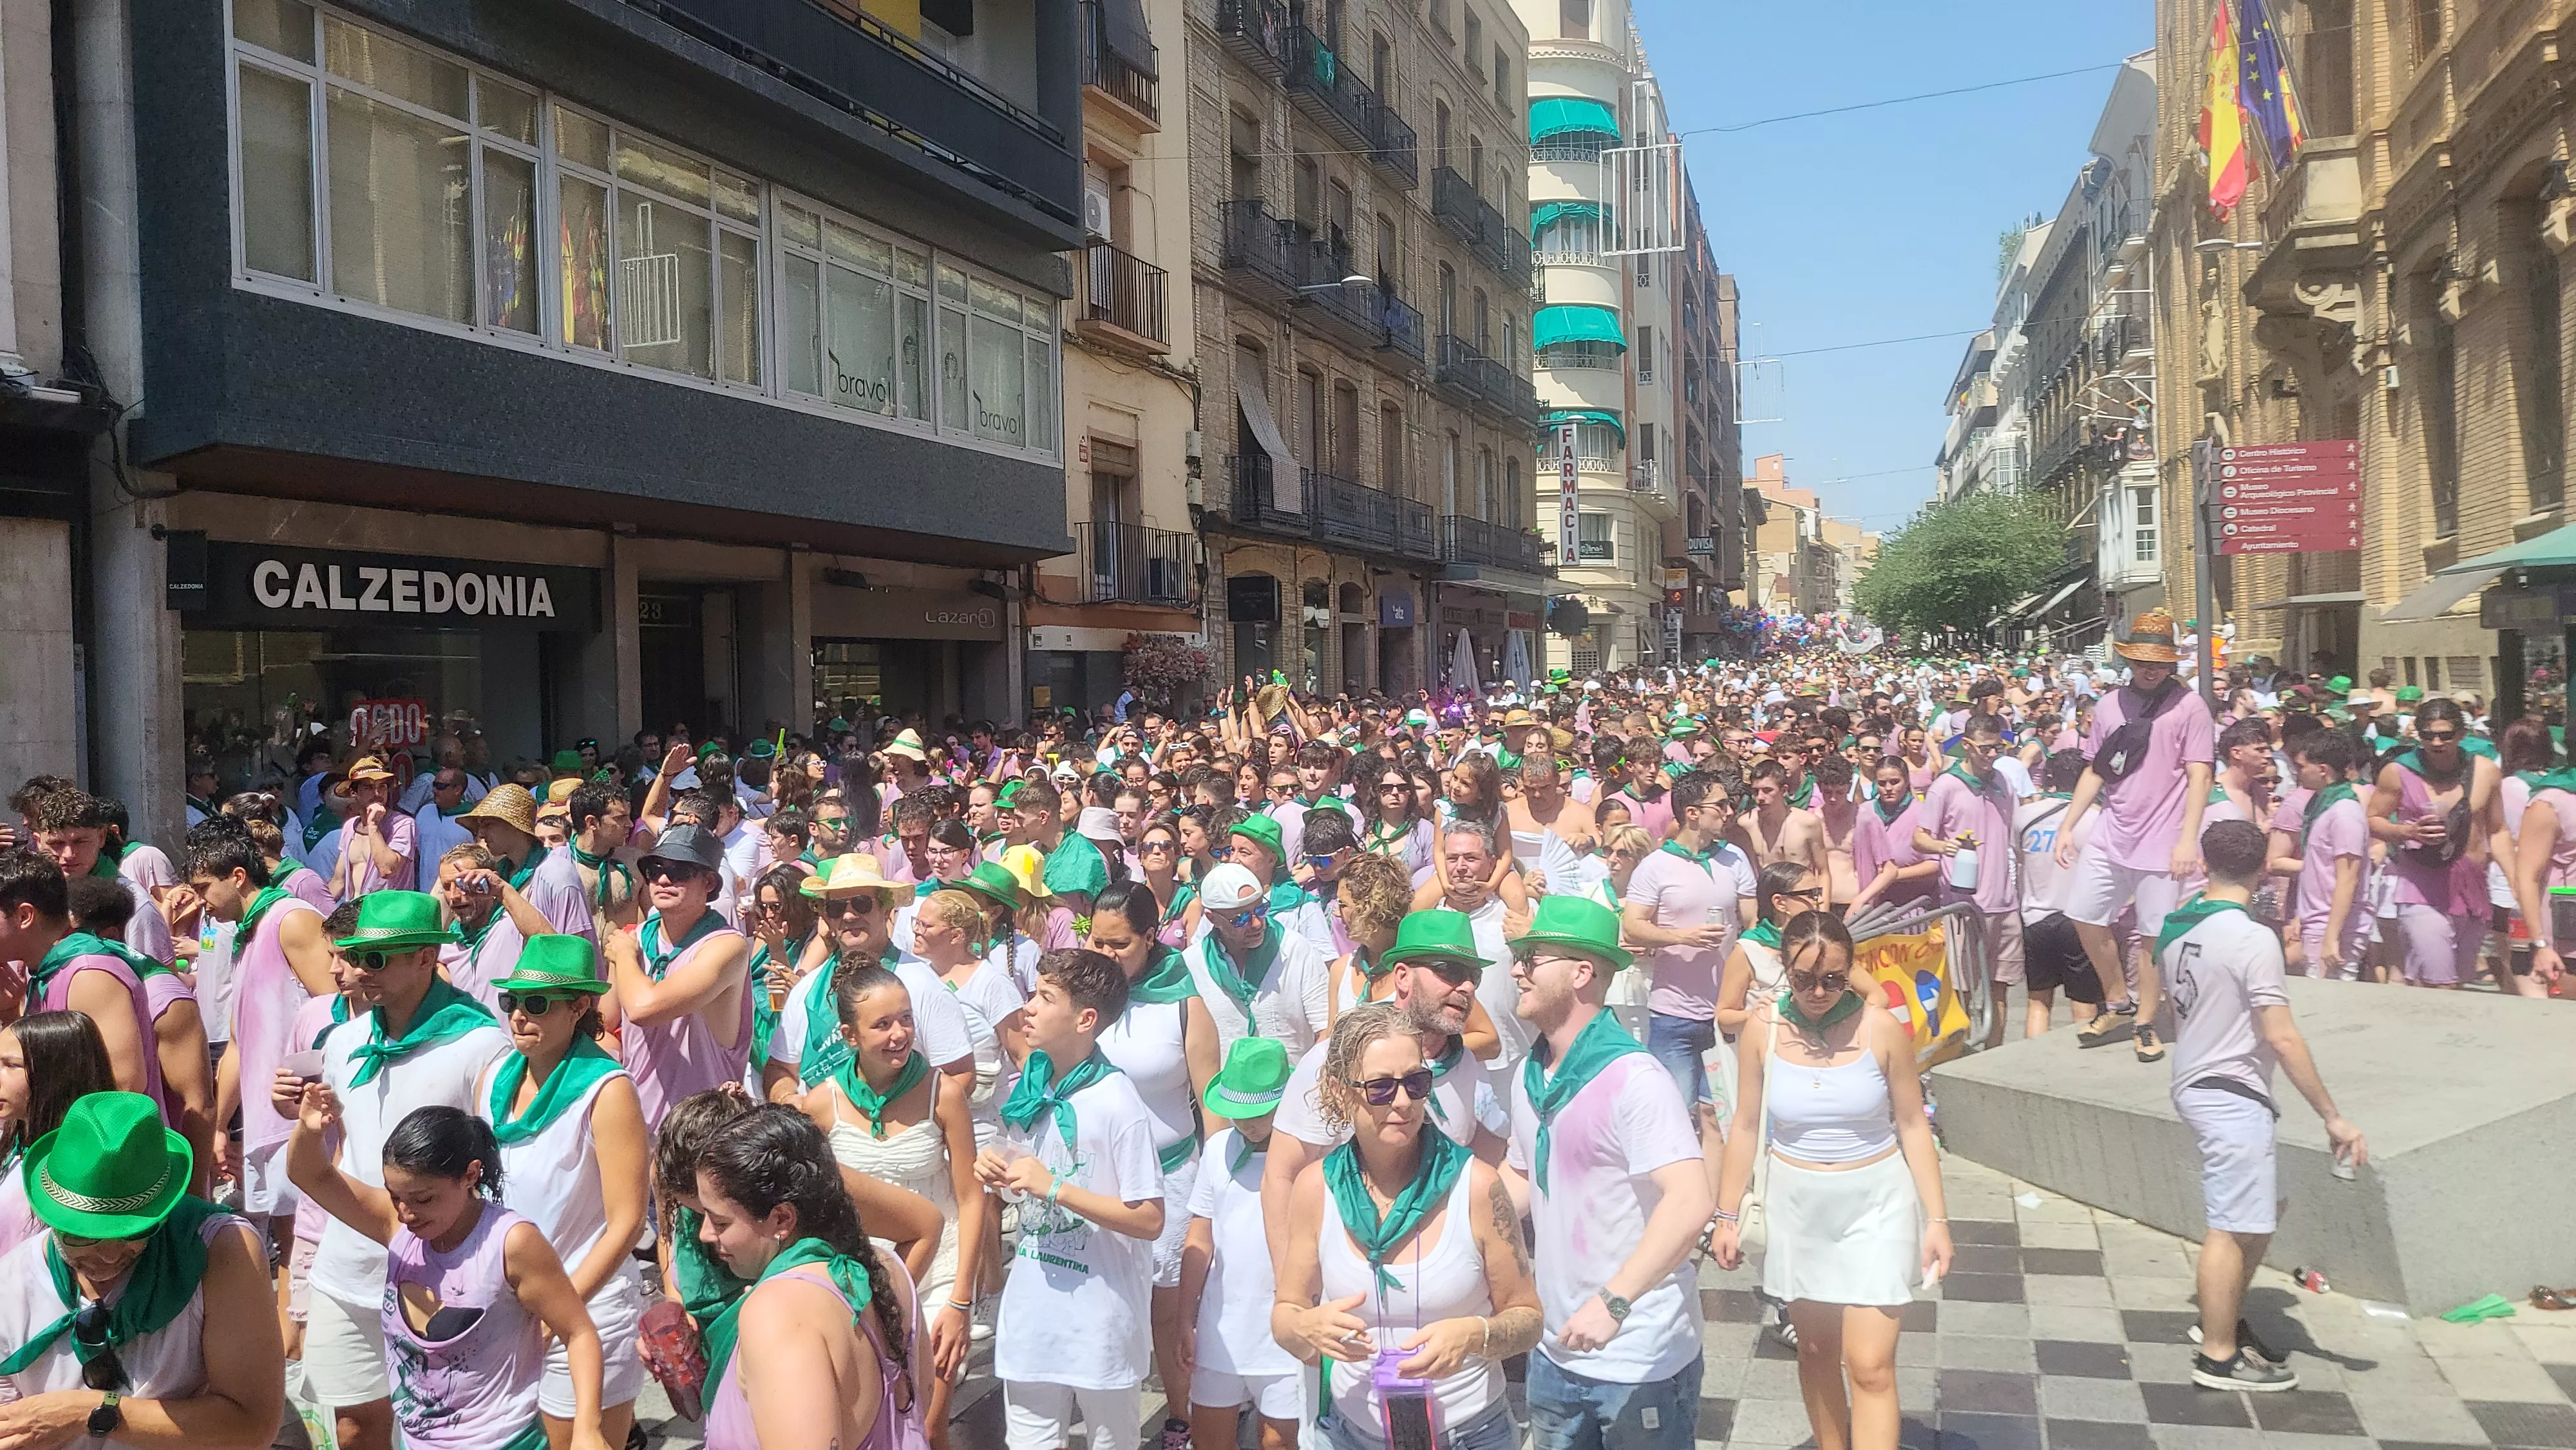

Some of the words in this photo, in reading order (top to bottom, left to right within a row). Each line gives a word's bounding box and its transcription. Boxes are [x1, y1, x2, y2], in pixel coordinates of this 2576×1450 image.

[1562, 428, 1576, 562] FARMACIA
[2297, 487, 2338, 496] Provincial
[2241, 541, 2298, 551] Ayuntamiento
[254, 560, 555, 617] CALZEDONIA
[2028, 830, 2056, 852] 27
[2173, 941, 2202, 1019] 5
